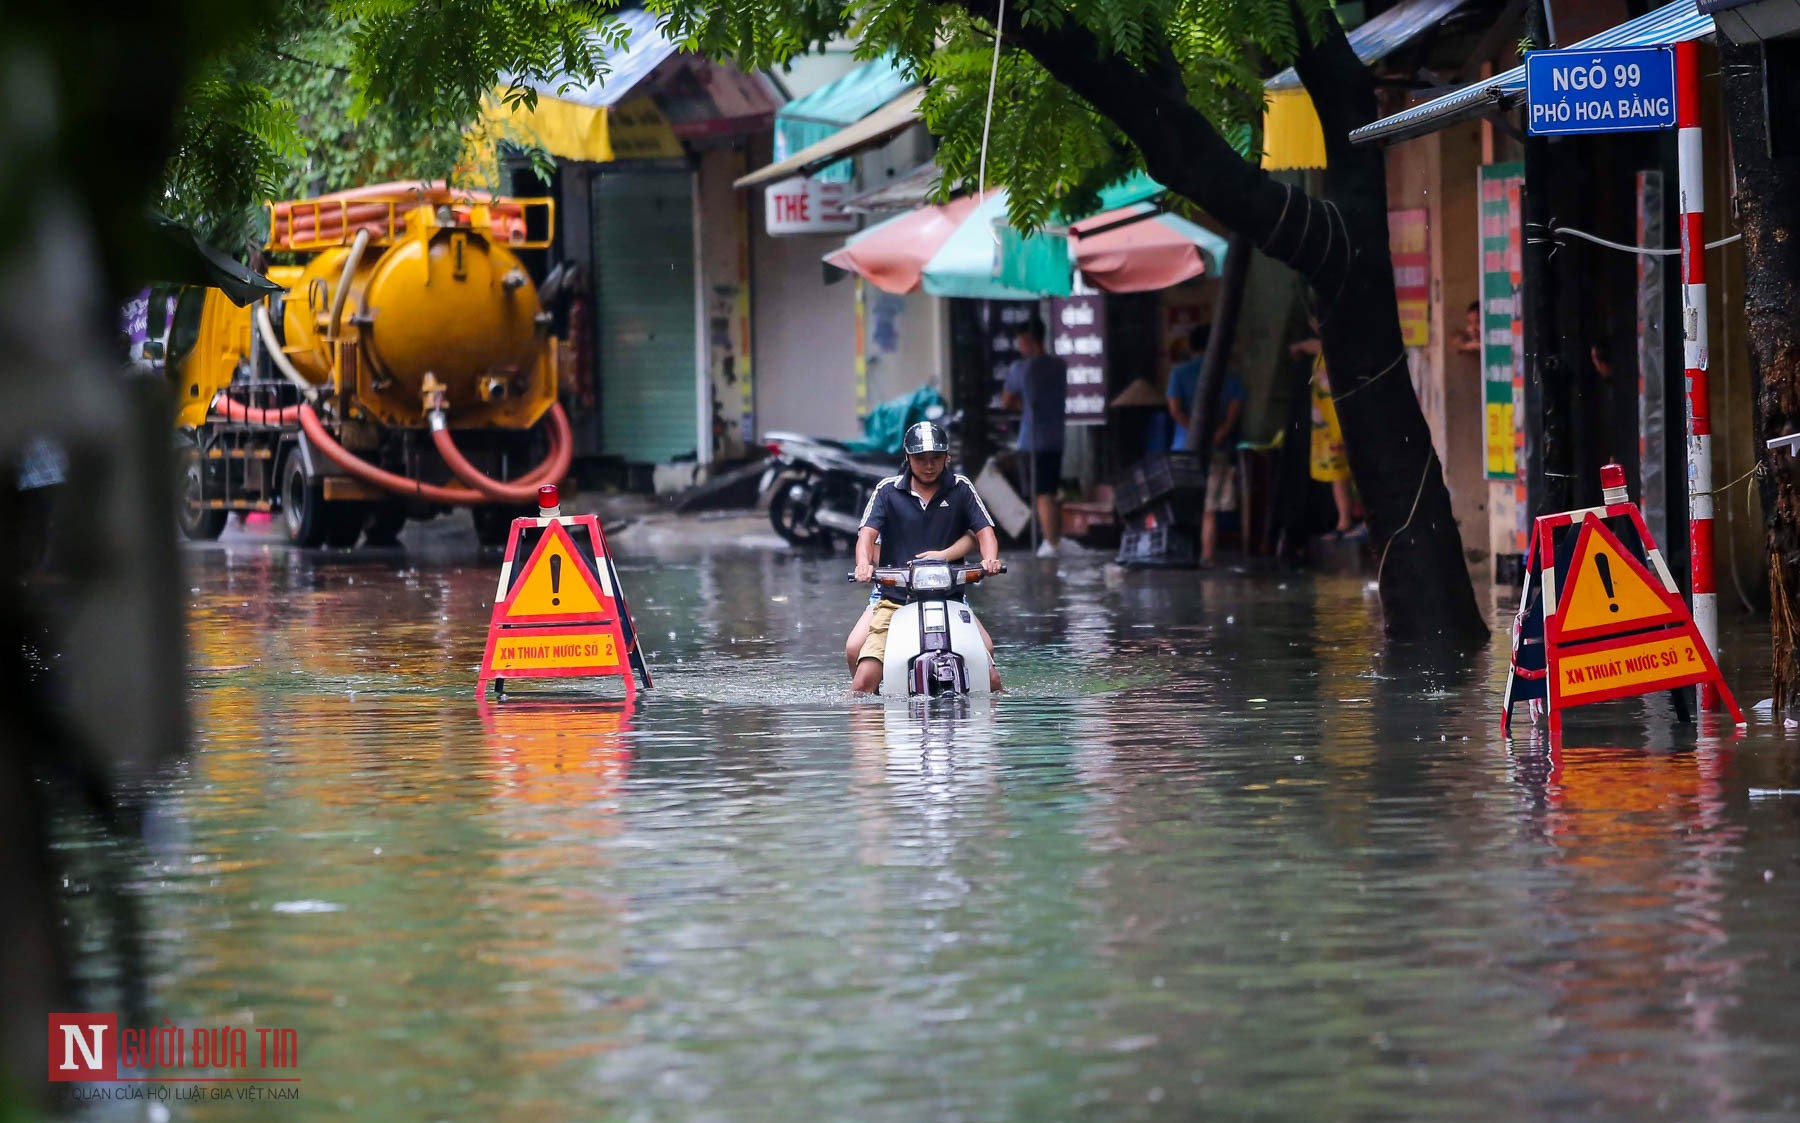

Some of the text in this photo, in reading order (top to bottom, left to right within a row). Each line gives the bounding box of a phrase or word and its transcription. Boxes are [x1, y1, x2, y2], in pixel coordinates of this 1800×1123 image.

[1552, 58, 1641, 91] NGÕ 99
[1533, 93, 1669, 123] PHỐ HOA BẰNG
[500, 647, 515, 660] XN
[606, 643, 613, 656] 2
[1565, 668, 1585, 685] XN
[1684, 647, 1696, 662] 2
